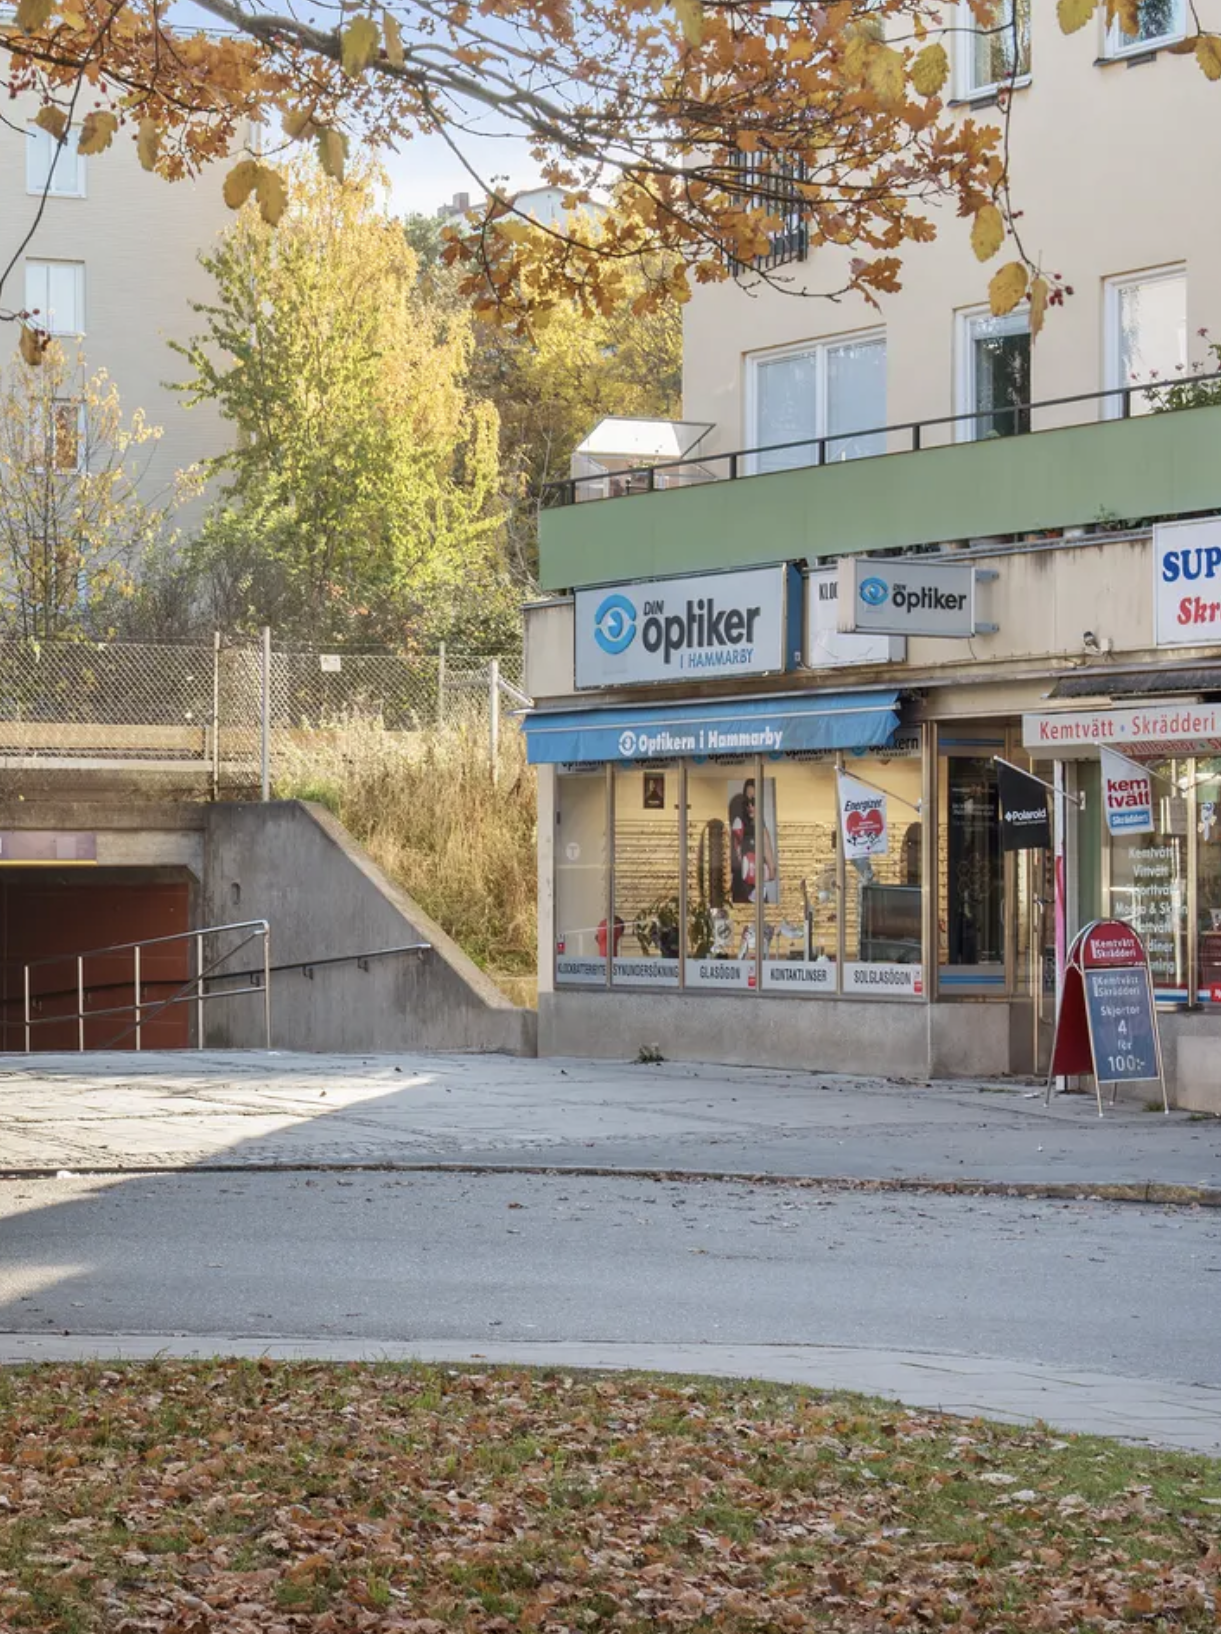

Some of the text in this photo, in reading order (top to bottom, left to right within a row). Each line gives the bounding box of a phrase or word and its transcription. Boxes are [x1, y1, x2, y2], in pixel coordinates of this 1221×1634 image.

[643, 600, 664, 616] DIN
[688, 648, 754, 668] HAMMARBY
[1039, 711, 1216, 740] Kemtvätt Skrädderi
[638, 726, 783, 755] Optikern i Hammarby
[1107, 778, 1149, 793] kem
[1107, 791, 1150, 808] tvätt
[1012, 808, 1046, 821] Polaroid
[699, 963, 741, 980] GLASÖGON
[770, 968, 827, 982] KONTAKTLINSER
[854, 968, 911, 985] SOLGLASÖGON
[1100, 1005, 1140, 1017] Skjortor
[1117, 1020, 1128, 1034] 4
[1107, 1055, 1146, 1072] 100:-
